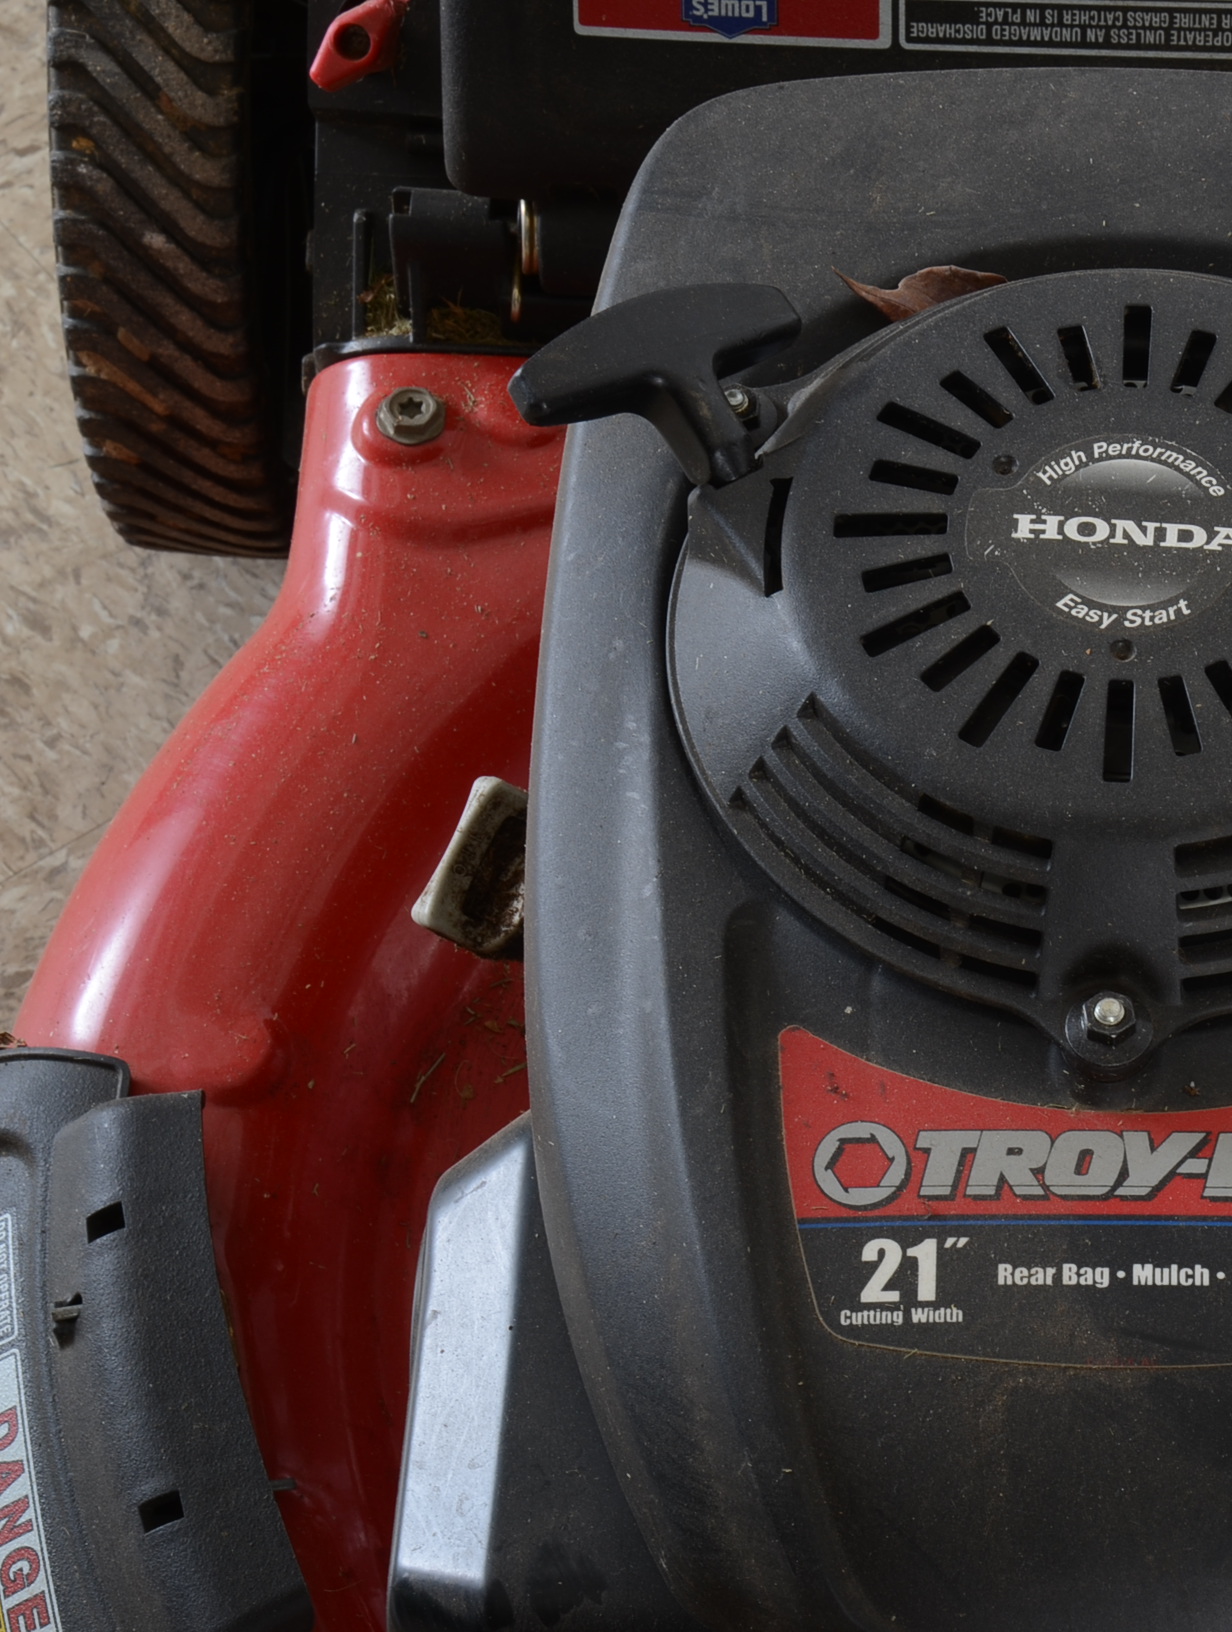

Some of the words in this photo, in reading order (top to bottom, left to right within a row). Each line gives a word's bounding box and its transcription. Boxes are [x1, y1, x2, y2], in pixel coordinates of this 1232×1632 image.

[691, 0, 768, 22] LOWE'S
[974, 7, 1021, 23] PLACE.
[1026, 8, 1039, 24] IN
[1045, 8, 1057, 24] IS
[1063, 10, 1123, 26] CATCHER
[1127, 11, 1170, 27] GRASS
[1173, 13, 1217, 29] ENTIRE
[910, 22, 986, 39] DISCHARGE
[992, 25, 1081, 42] UNDAMAGED
[1087, 28, 1105, 43] AN
[1110, 29, 1165, 45] UNLESS
[1170, 30, 1232, 47] OPERATE
[1037, 450, 1087, 486] High
[1093, 440, 1225, 498] Performance
[1055, 593, 1118, 630] Easy
[1123, 598, 1192, 629] Start
[997, 1263, 1057, 1287] Rear
[1063, 1263, 1110, 1290] Bag
[1132, 1264, 1210, 1288] Mulch
[839, 1307, 903, 1326] Cutting
[910, 1306, 964, 1324] Width
